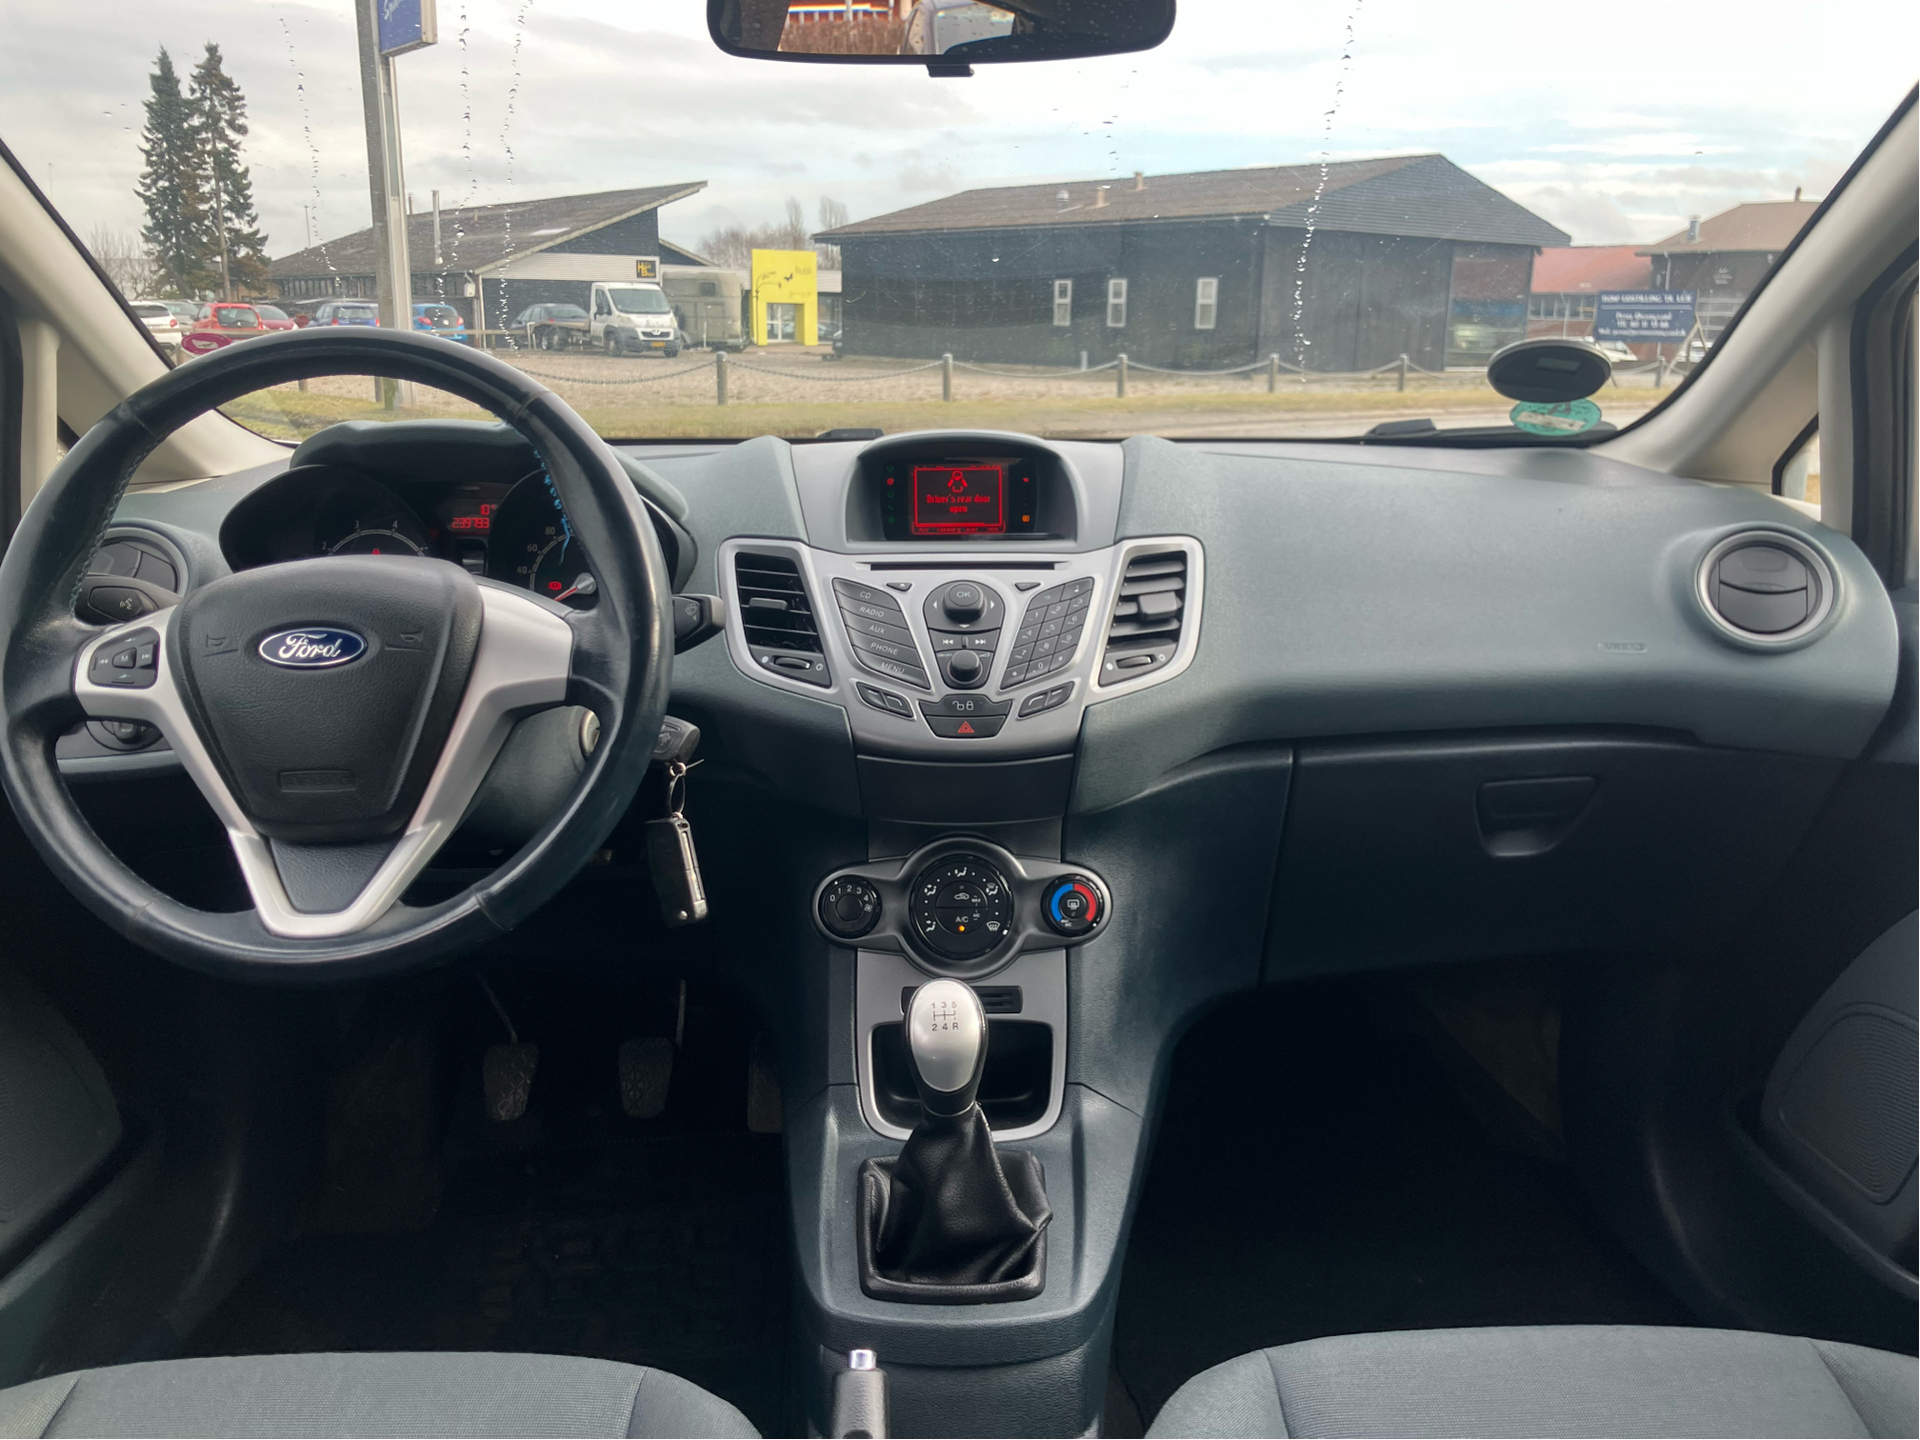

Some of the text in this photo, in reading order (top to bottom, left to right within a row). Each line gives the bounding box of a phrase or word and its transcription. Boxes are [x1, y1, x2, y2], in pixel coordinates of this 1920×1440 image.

[926, 494, 955, 503] Driver's
[974, 494, 990, 503] door
[949, 505, 968, 513] open
[392, 520, 398, 529] 4
[545, 526, 556, 535] 80
[527, 543, 538, 552] 60
[516, 566, 527, 574] 40
[860, 591, 872, 599] CD
[859, 607, 885, 618] RADIO
[868, 625, 886, 635] AUX
[278, 633, 342, 659] Ford
[870, 642, 899, 656] PHONE
[121, 654, 129, 662] M
[880, 662, 905, 674] MENU
[830, 894, 836, 902] 0
[846, 884, 853, 893] 2
[856, 886, 862, 895] 3
[863, 894, 869, 902] 4
[941, 1001, 947, 1009] 3
[951, 1001, 957, 1009] 5
[931, 1022, 959, 1031] 2 4 R
